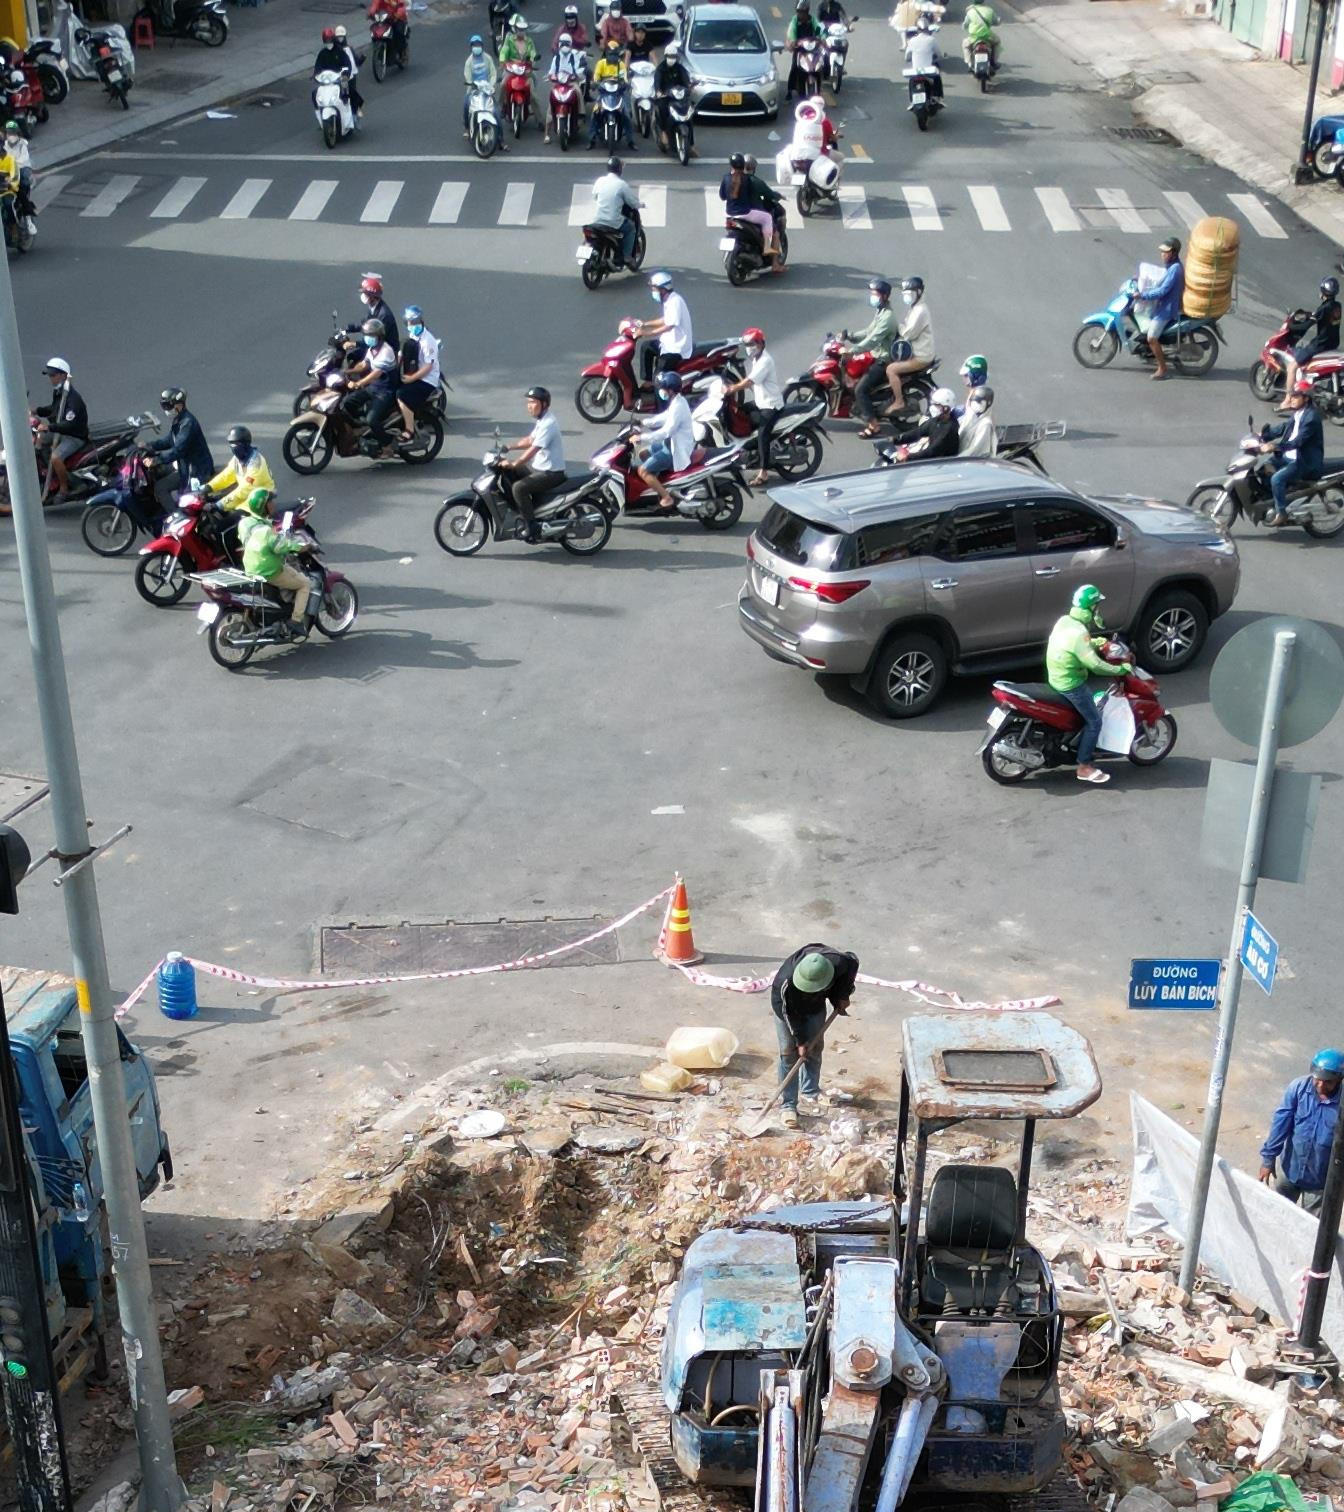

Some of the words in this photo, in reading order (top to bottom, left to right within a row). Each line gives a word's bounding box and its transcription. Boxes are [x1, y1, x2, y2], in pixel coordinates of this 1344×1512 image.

[1152, 964, 1198, 978] ĐƯỜNG
[1134, 981, 1157, 1000] LŨY
[1161, 981, 1186, 1000] BÁN
[1188, 980, 1217, 1001] BÍCH
